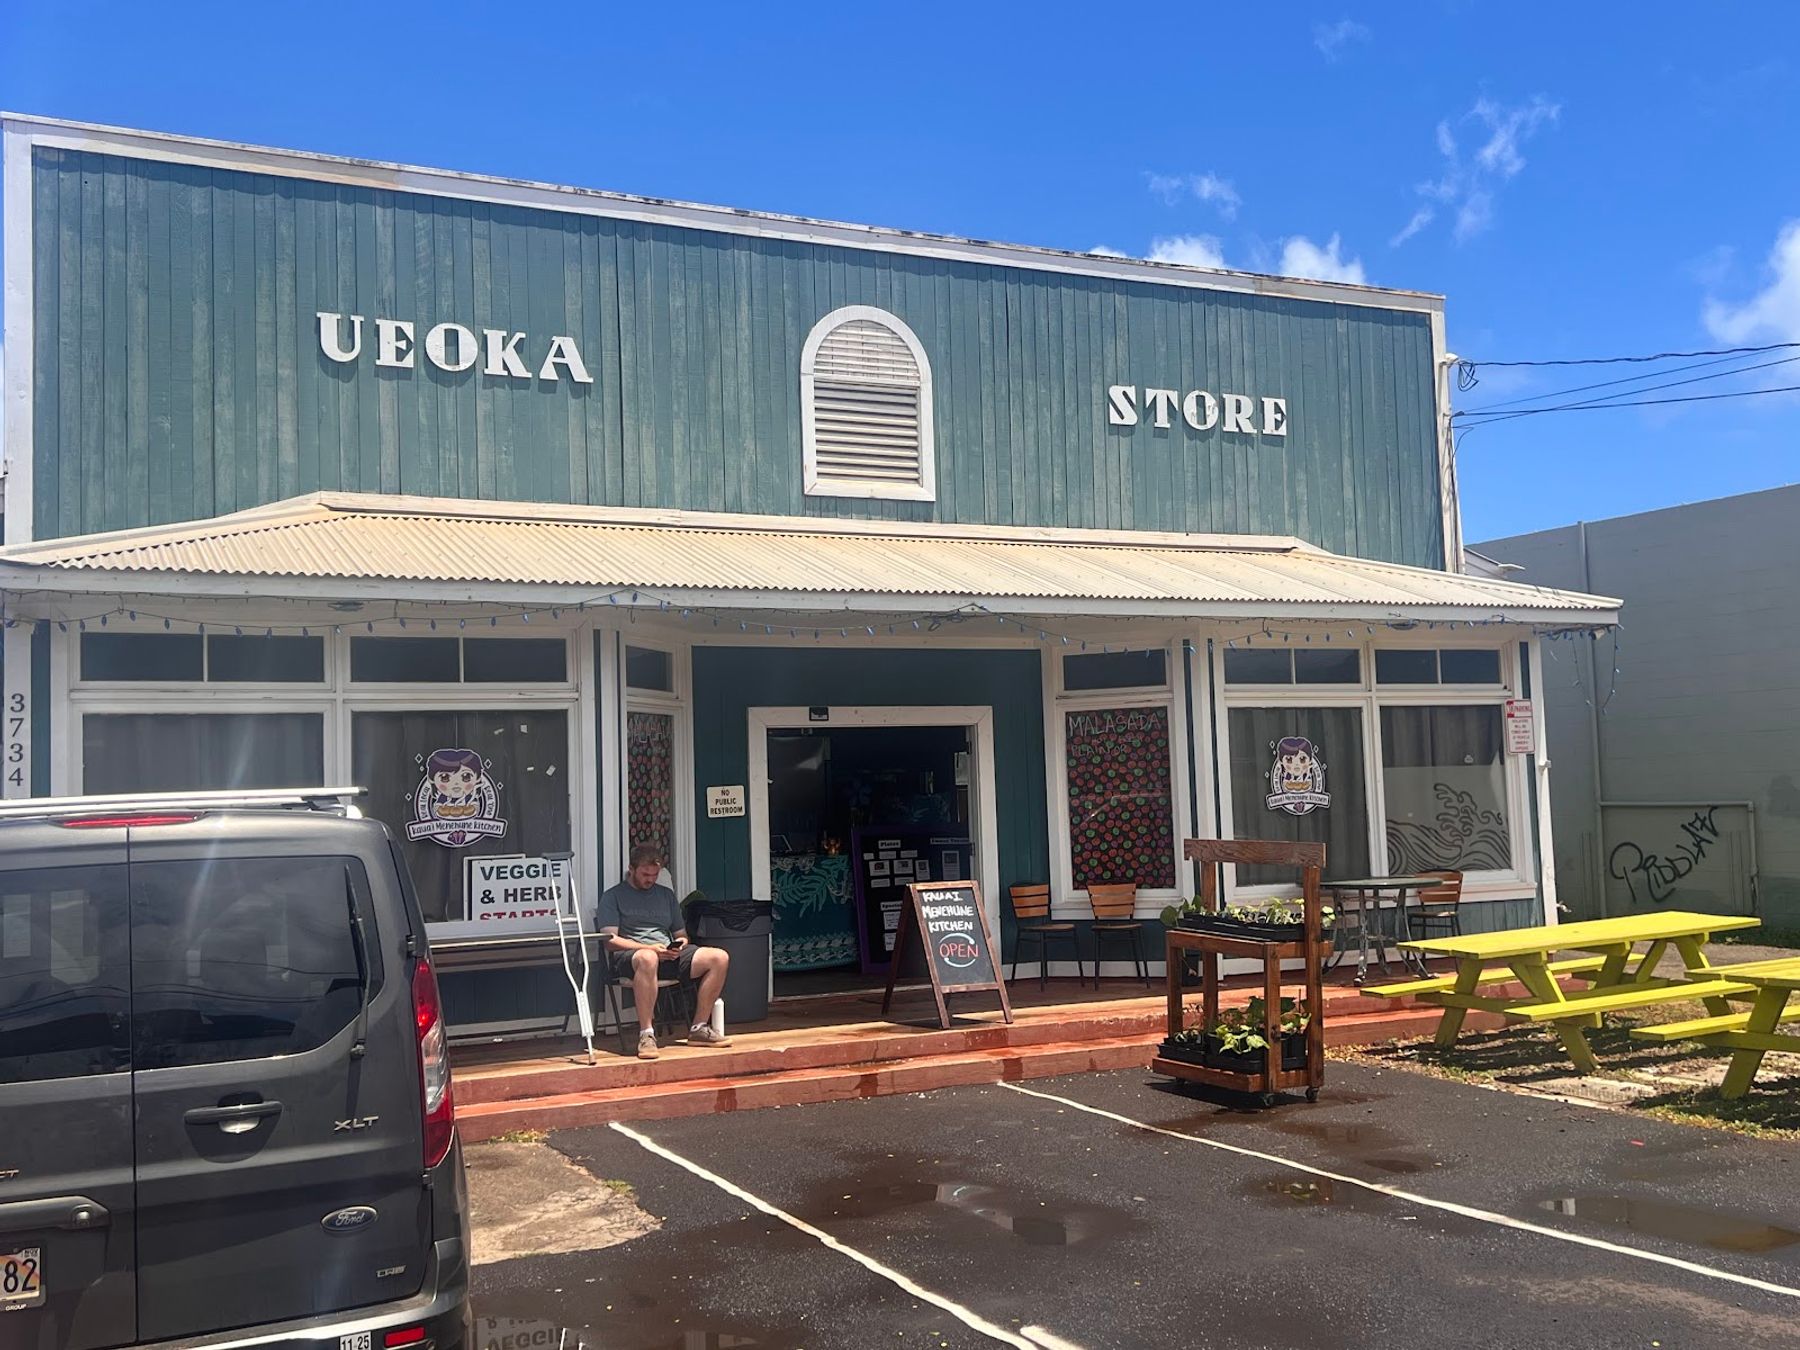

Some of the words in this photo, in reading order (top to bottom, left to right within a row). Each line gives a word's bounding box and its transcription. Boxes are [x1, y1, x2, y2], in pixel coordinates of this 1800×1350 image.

[316, 311, 594, 383] UEOKA
[1108, 385, 1287, 436] STORE
[1068, 712, 1161, 737] MALASADA
[8, 693, 25, 786] 3734
[715, 797, 737, 806] PUBLIC
[710, 806, 743, 815] RESTROOM
[480, 863, 562, 881] VEGGIE
[480, 889, 495, 904] &
[503, 885, 562, 904] HERB
[922, 891, 964, 902] KAUAI
[921, 905, 974, 919] MENEHUNE
[928, 920, 974, 933] KITCHEN
[939, 942, 979, 958] OPEN
[333, 1115, 379, 1130] XLT
[335, 1210, 366, 1226] Ford
[5, 1303, 27, 1311] GROUP
